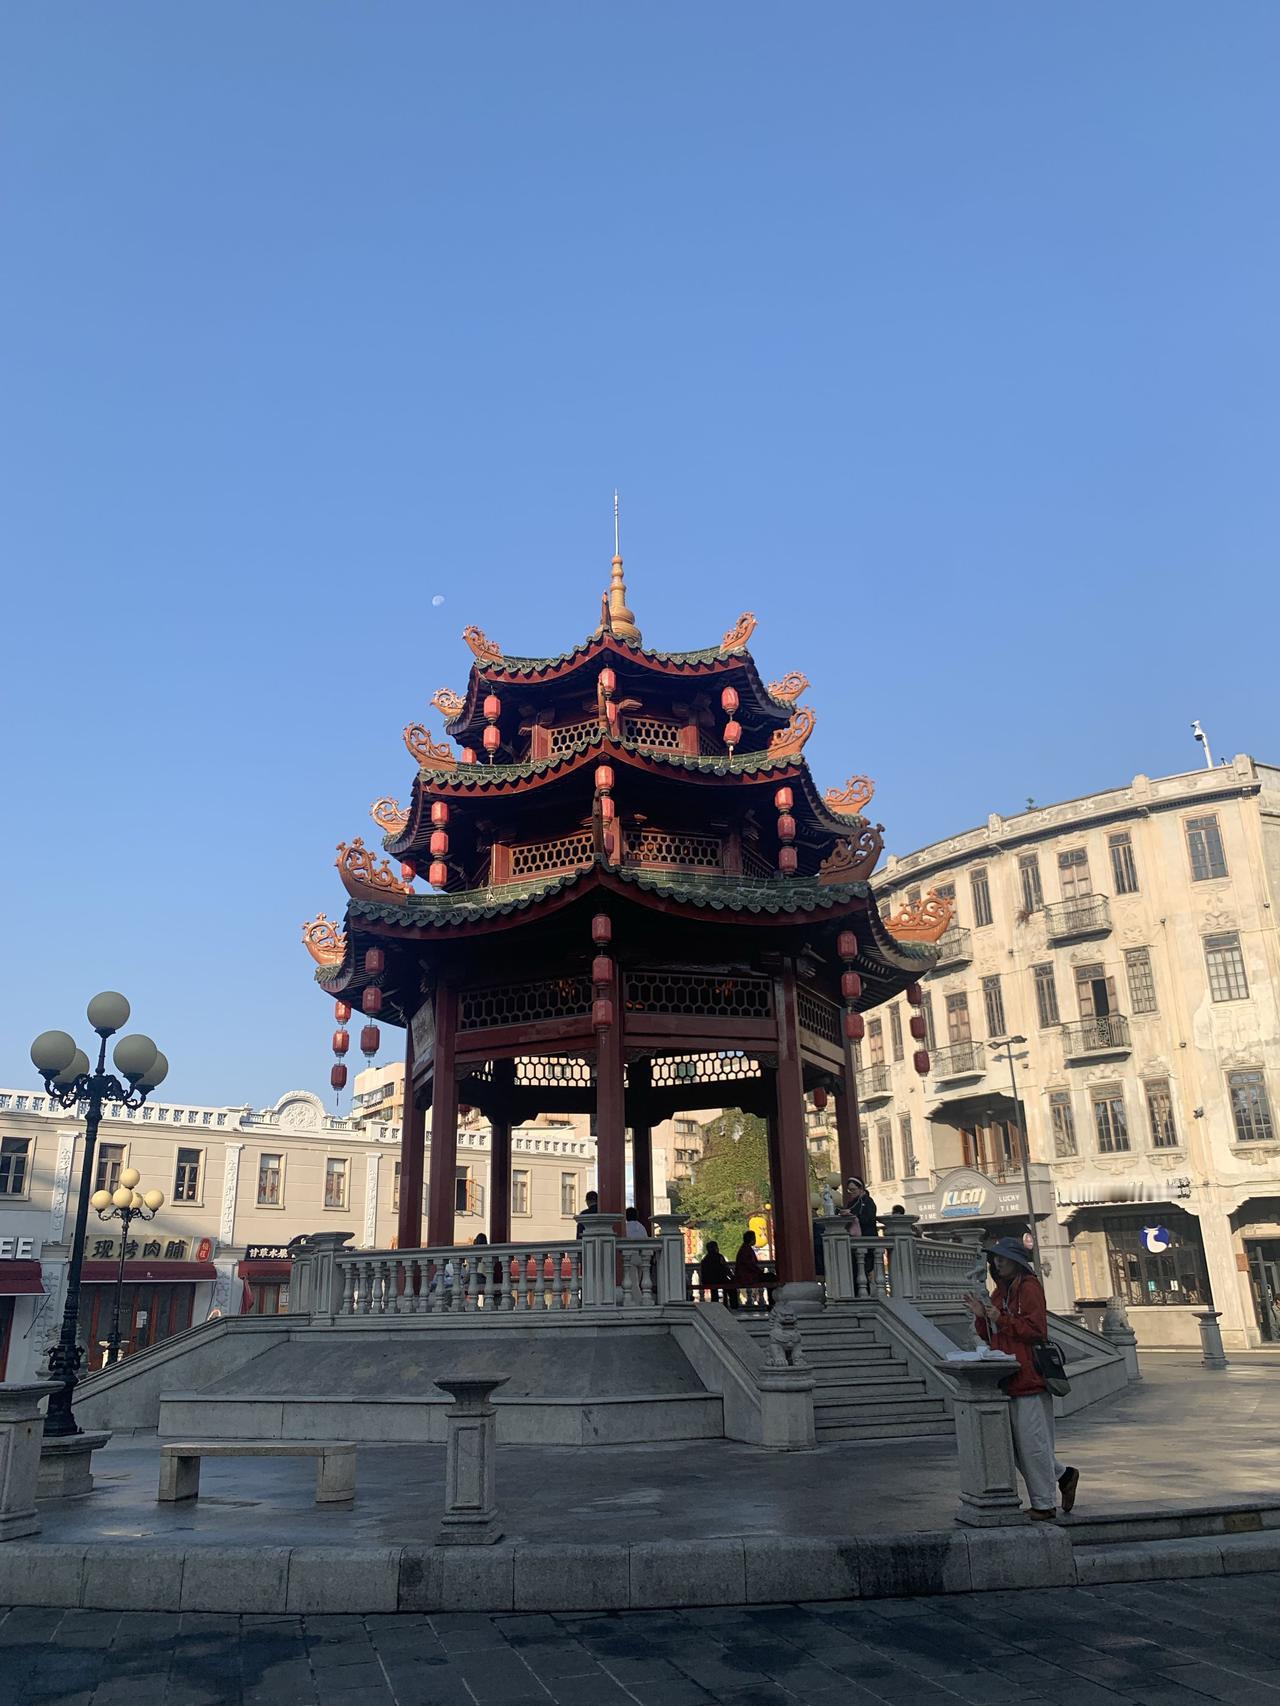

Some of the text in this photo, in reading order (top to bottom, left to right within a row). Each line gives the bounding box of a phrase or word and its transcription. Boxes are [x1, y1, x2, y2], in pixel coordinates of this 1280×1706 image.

[999, 1194, 1020, 1203] LUCKY
[918, 1203, 936, 1211] GAME
[1000, 1203, 1020, 1212] TIME
[919, 1212, 937, 1220] TIME
[84, 1239, 188, 1259] 现烤肉脯
[249, 1247, 296, 1259] 甘草水果
